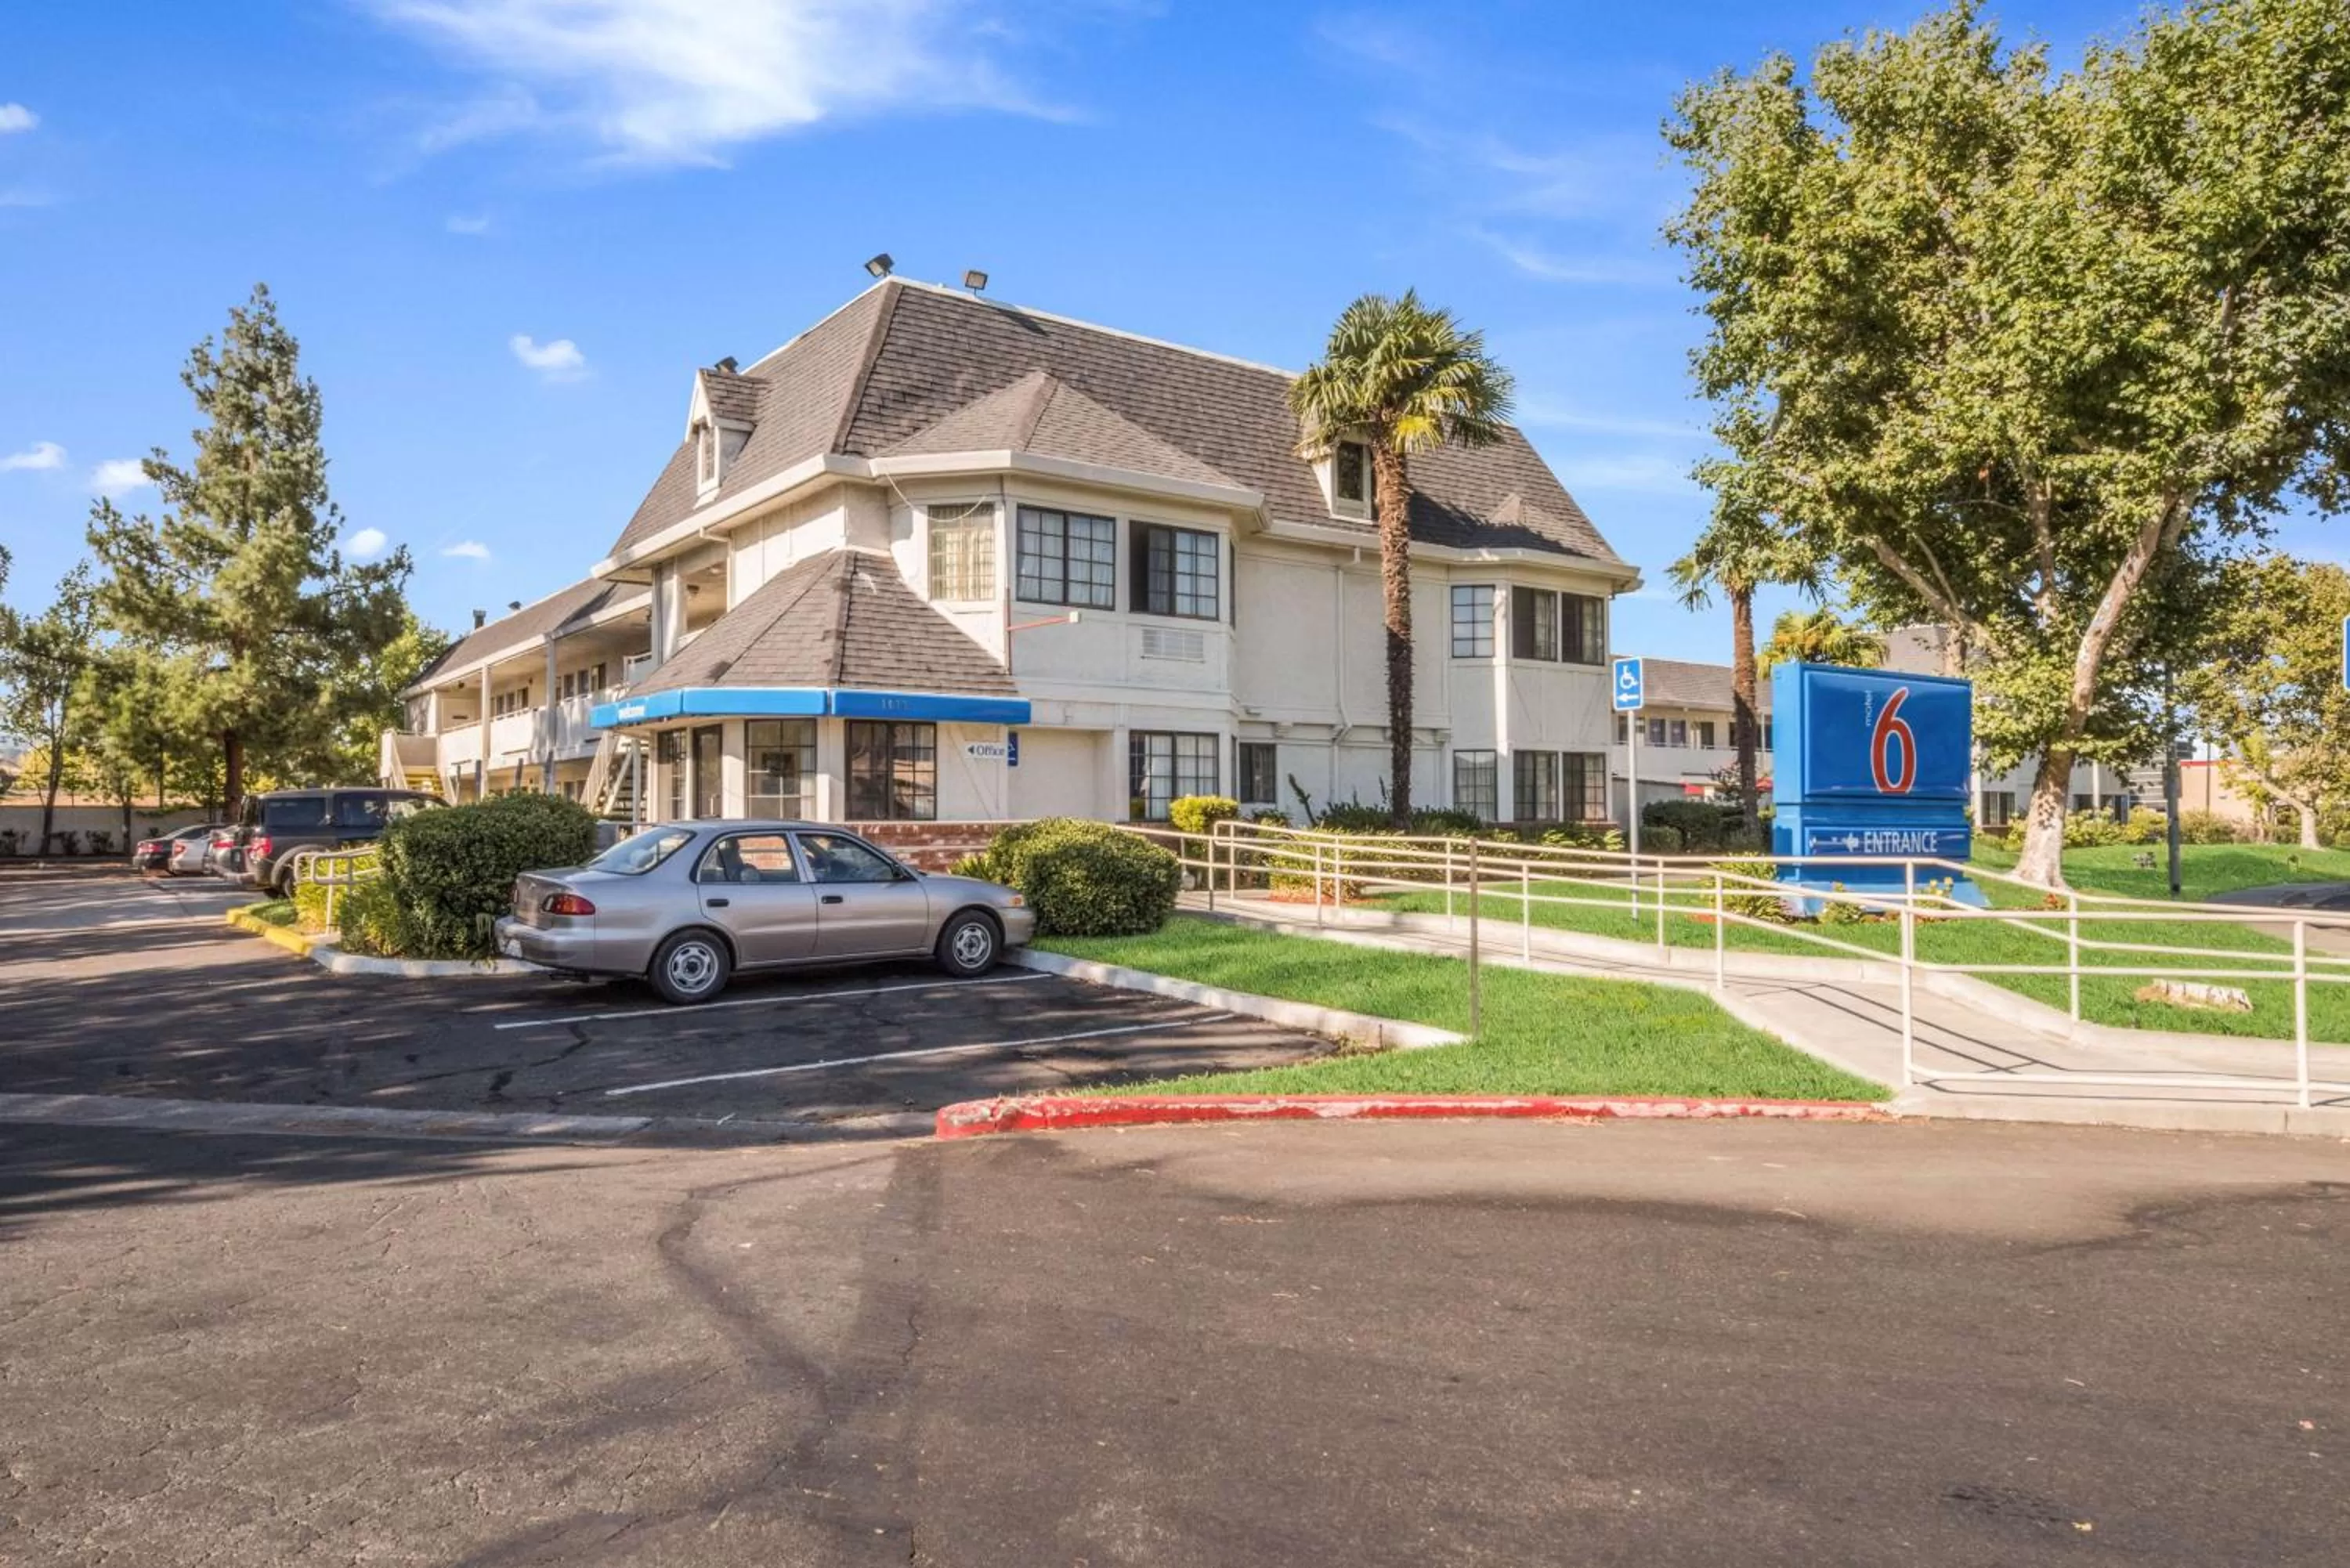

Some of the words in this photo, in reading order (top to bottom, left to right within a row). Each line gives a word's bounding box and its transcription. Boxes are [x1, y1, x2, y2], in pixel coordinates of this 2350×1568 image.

[976, 745, 1005, 756] Office
[1871, 686, 1917, 794] 6
[1864, 832, 1938, 853] ENTRANCE
